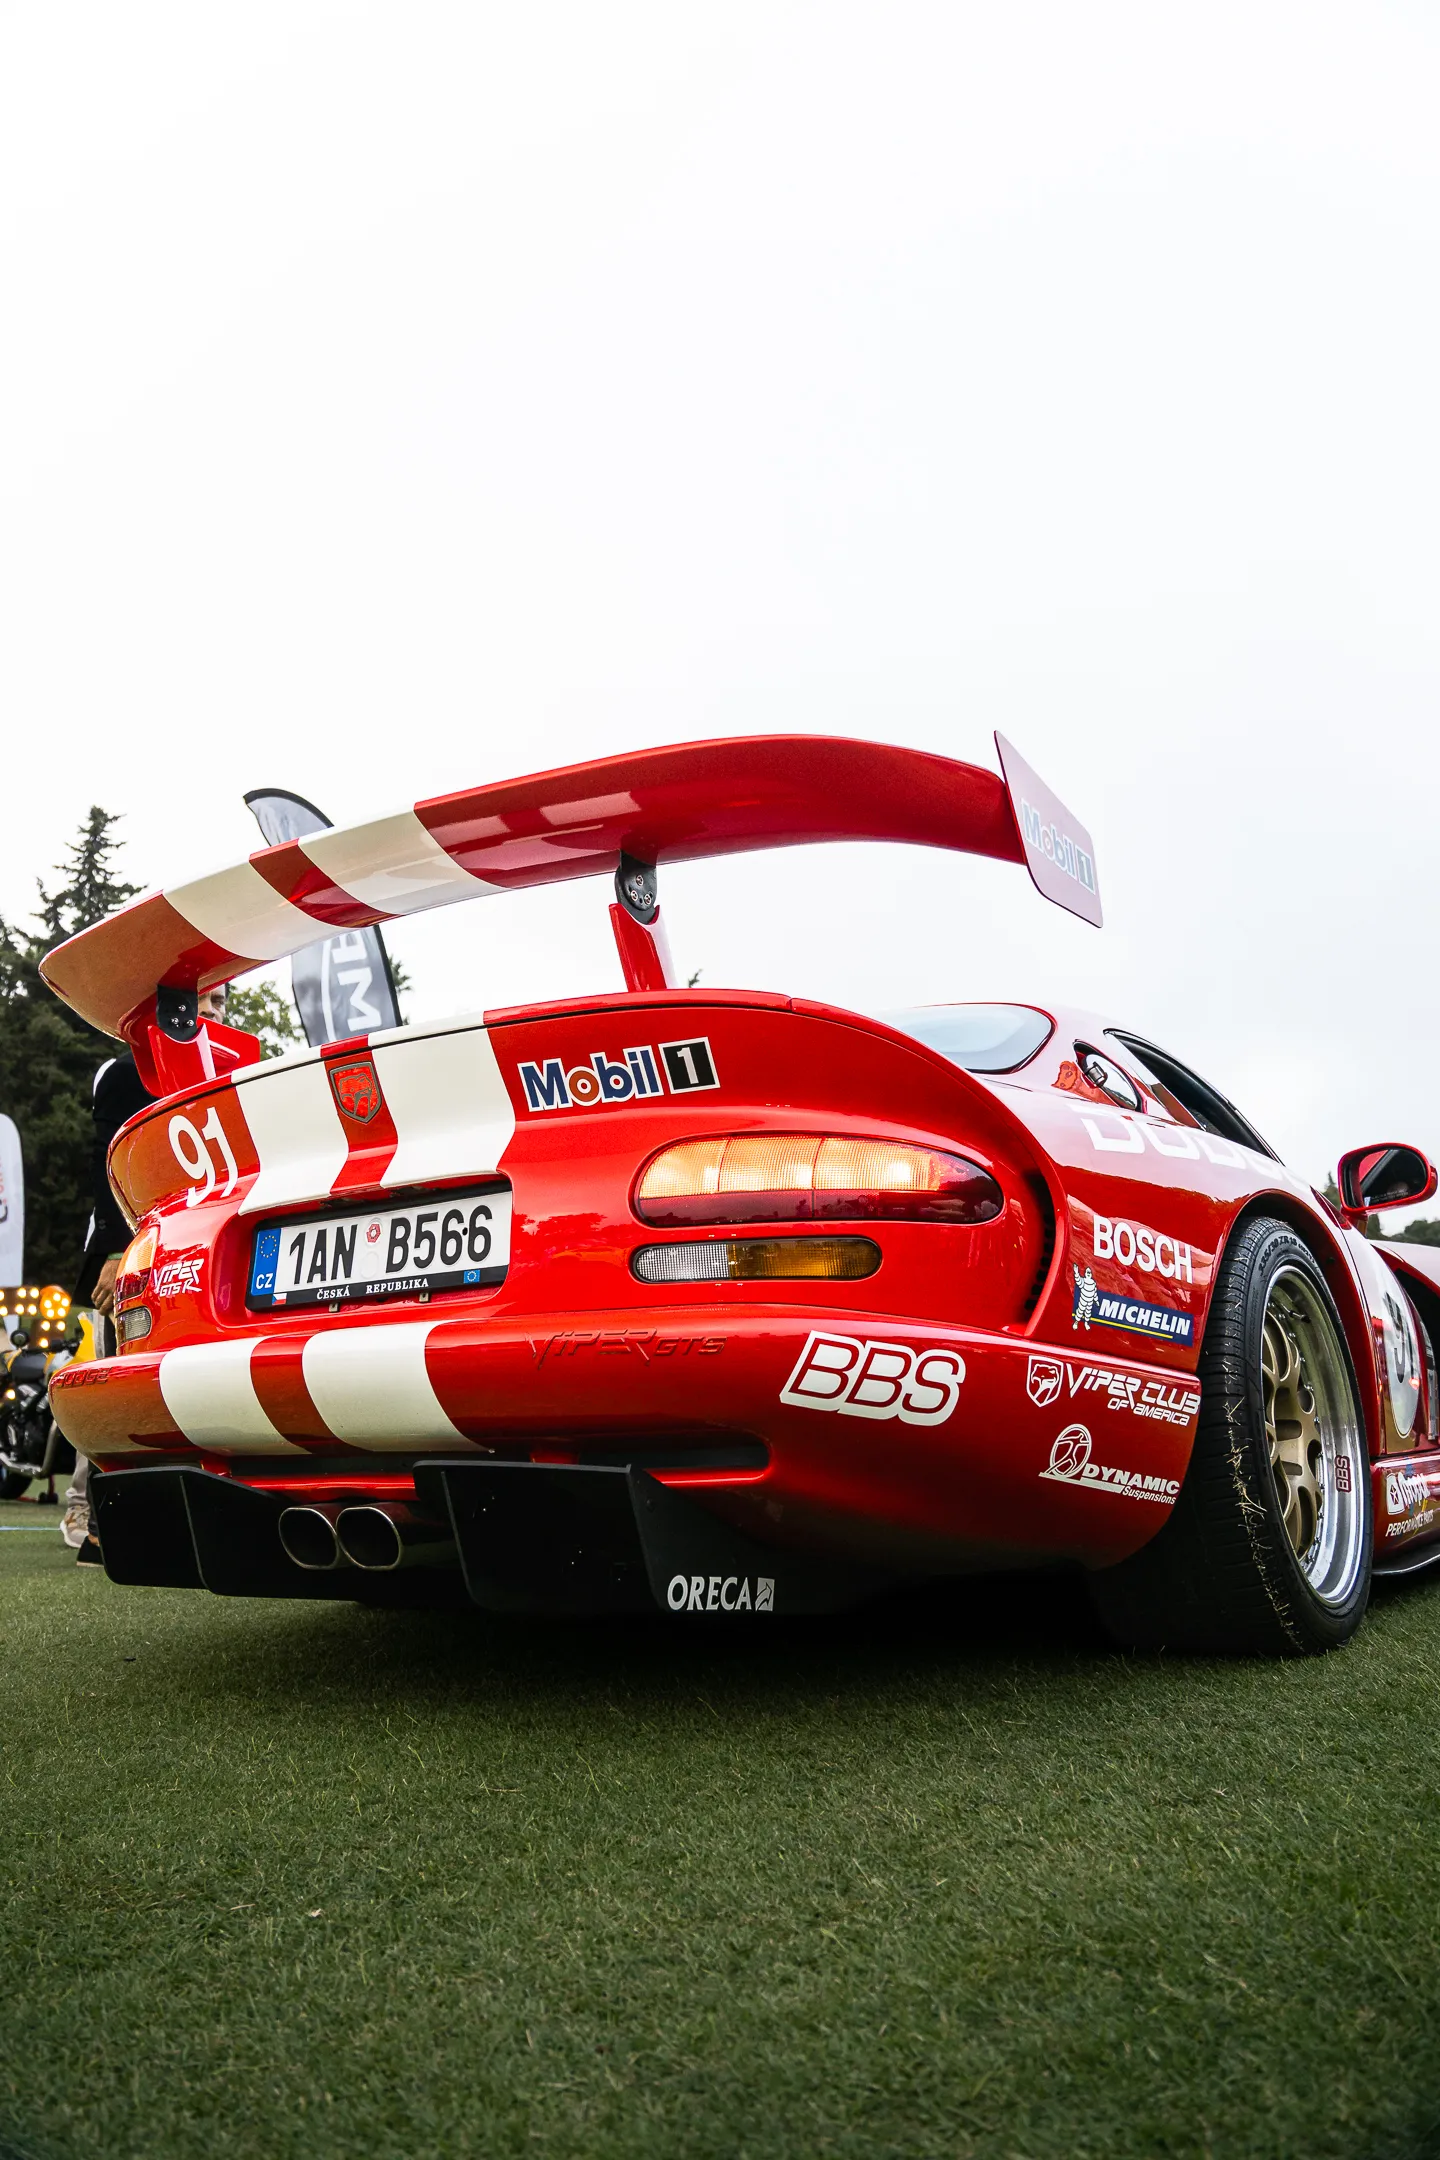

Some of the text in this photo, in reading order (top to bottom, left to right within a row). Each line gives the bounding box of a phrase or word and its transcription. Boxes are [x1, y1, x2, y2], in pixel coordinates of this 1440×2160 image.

[1022, 799, 1076, 879] Mobil
[518, 1046, 662, 1111] Mobil
[168, 1106, 239, 1208] 91
[289, 1204, 493, 1285] 1AN B566
[1093, 1213, 1193, 1284] BOSCH
[256, 1273, 274, 1290] CZ
[316, 1277, 429, 1300] ČESKÁ REPUBLIKA
[1098, 1298, 1191, 1336] MICHELIN
[653, 1336, 728, 1357] GTS
[780, 1331, 965, 1425] BBS
[1107, 1397, 1130, 1411] OF
[1140, 1381, 1201, 1415] CLUB
[1081, 1463, 1180, 1495] DYNAMIC
[1336, 1456, 1350, 1493] BBS
[1122, 1485, 1177, 1505] Suspensions
[667, 1574, 752, 1611] ORECA
